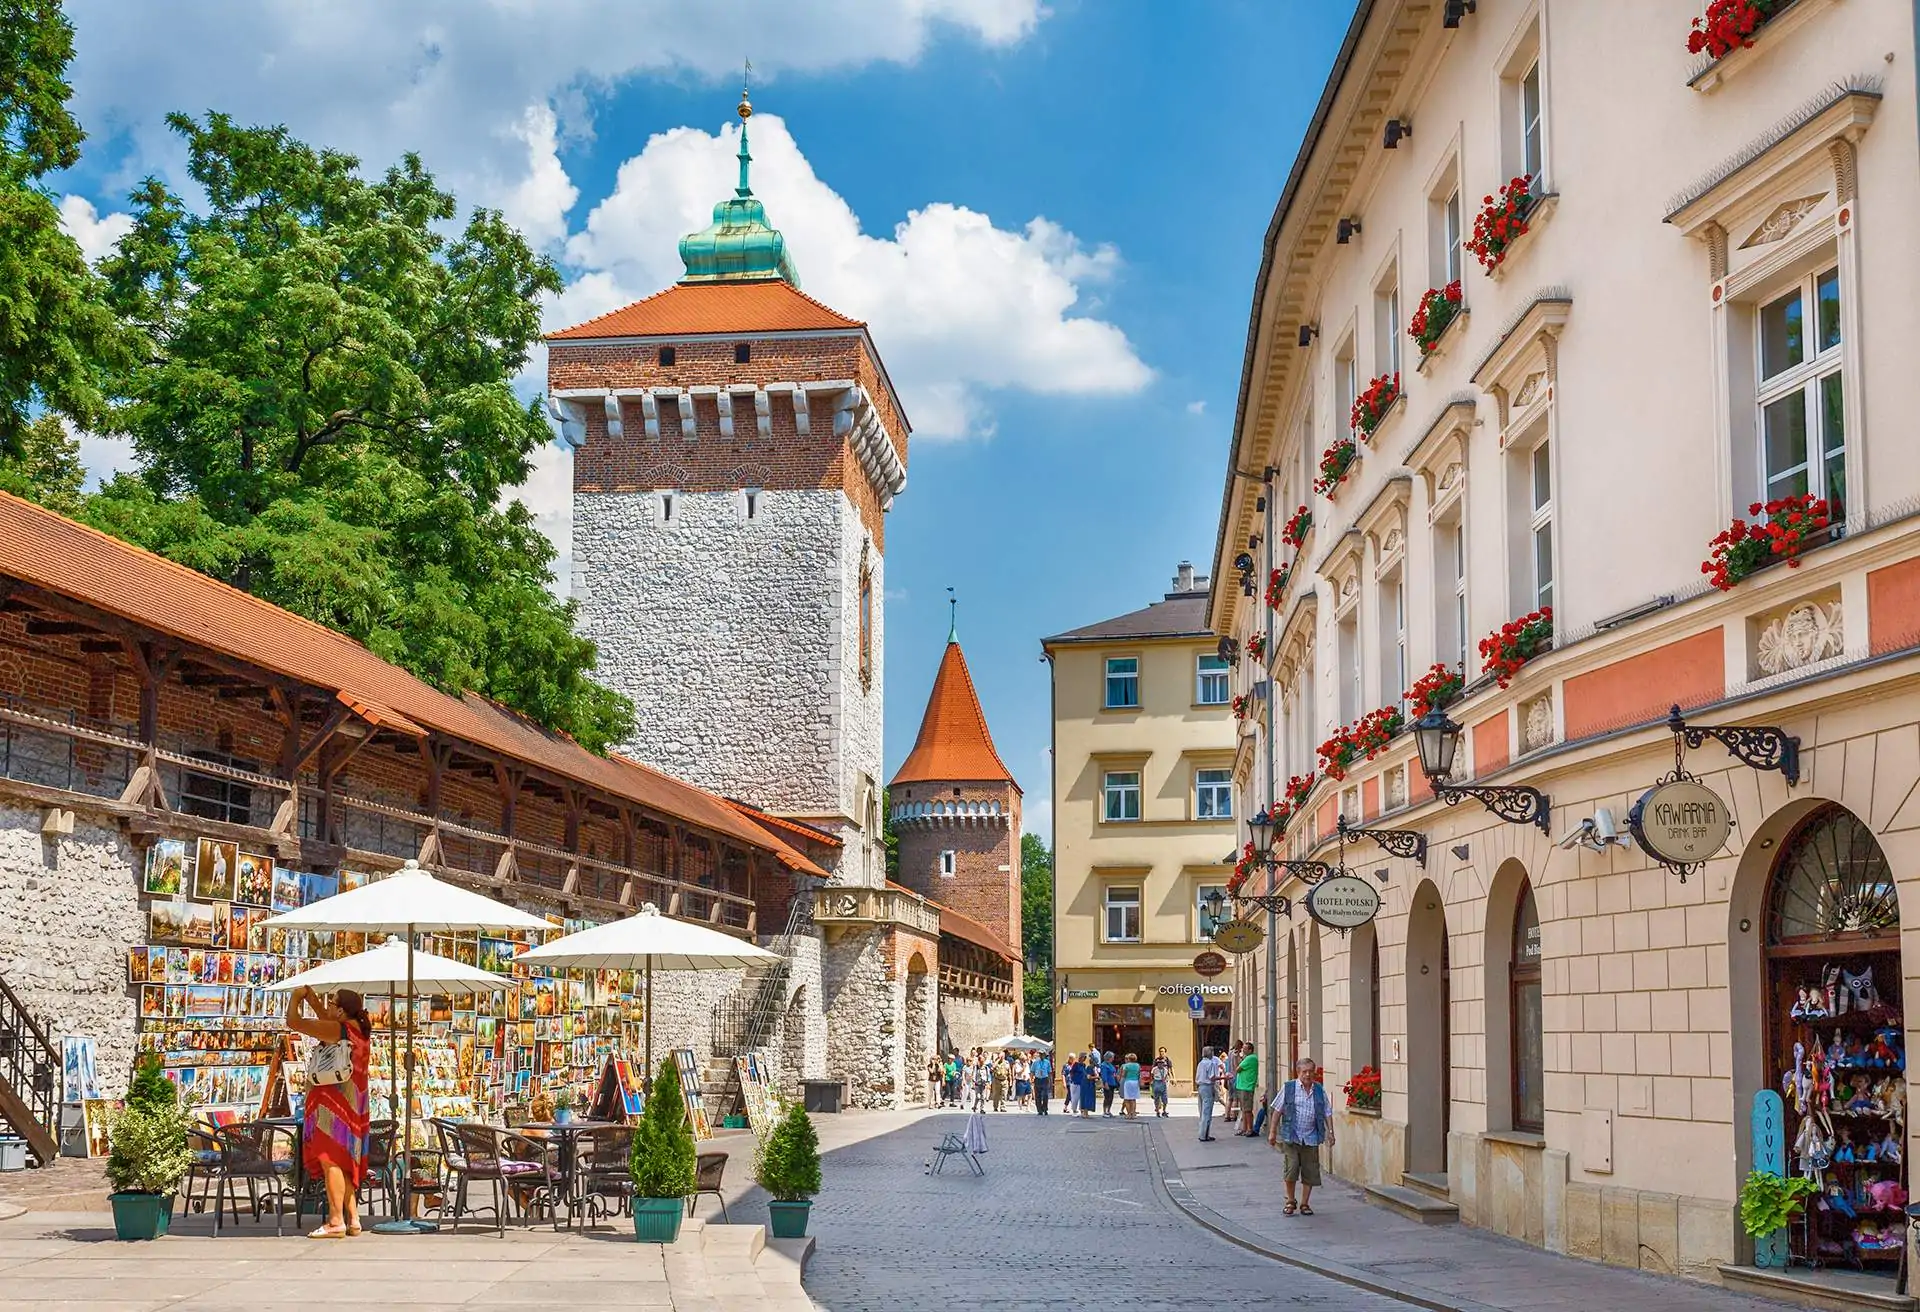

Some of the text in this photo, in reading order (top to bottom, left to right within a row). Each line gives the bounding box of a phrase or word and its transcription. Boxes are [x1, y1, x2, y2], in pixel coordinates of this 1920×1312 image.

[1655, 802, 1717, 826] KAWIARNIA
[1668, 827, 1708, 839] DRINK BAR
[1316, 898, 1374, 907] HOTEL POLSKI
[1320, 908, 1331, 916] Pod
